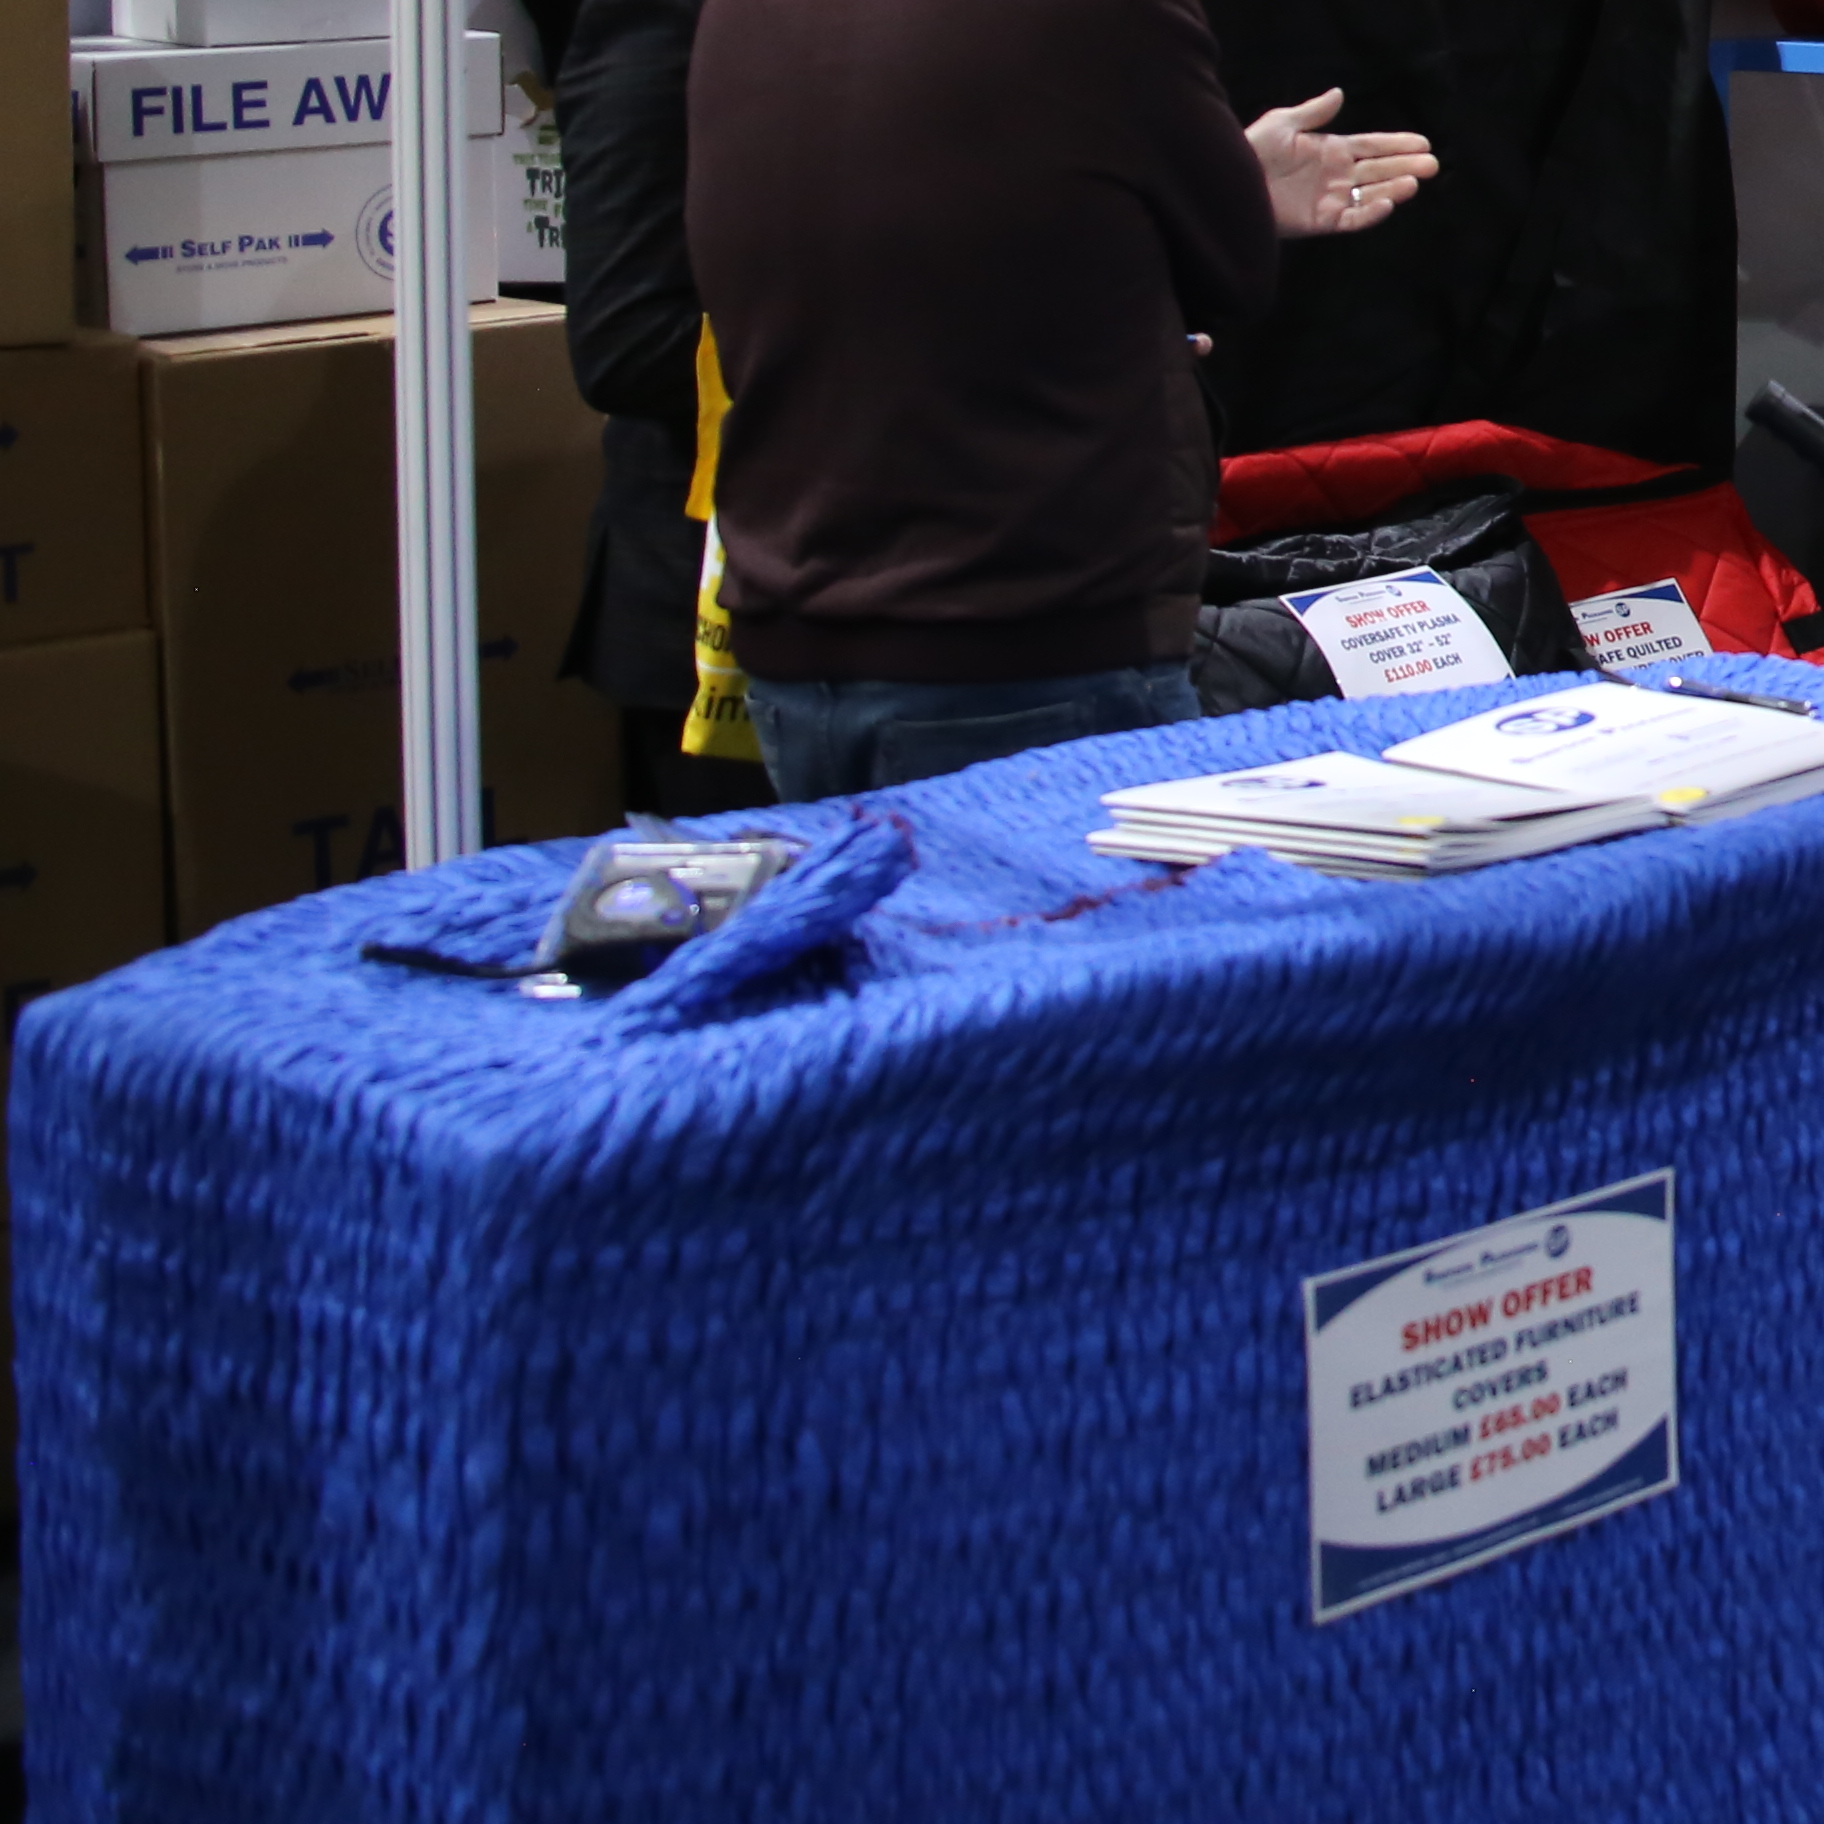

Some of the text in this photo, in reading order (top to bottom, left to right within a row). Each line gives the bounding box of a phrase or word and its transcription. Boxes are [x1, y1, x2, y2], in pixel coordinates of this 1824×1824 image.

[130, 71, 393, 139] FILE AW
[180, 233, 281, 259] SELF PAK
[1340, 613, 1462, 651] COVERSAFE TV PLASMA
[1344, 599, 1432, 629] SHOW OFFER
[1603, 621, 1654, 643] OFFER
[1369, 645, 1406, 664] COVER
[1626, 636, 1683, 660] QUILTED
[1384, 652, 1463, 683] £110.00 EACH
[1402, 1265, 1595, 1354] SHOW OFFER
[1348, 1290, 1643, 1411] ELASTICATED FURNITURE
[1452, 1360, 1550, 1412] COVERS
[1364, 1424, 1472, 1479] MEDIUM
[1566, 1367, 1630, 1409] EACH
[1375, 1464, 1462, 1515] LARGE
[1558, 1408, 1620, 1451] EACH
